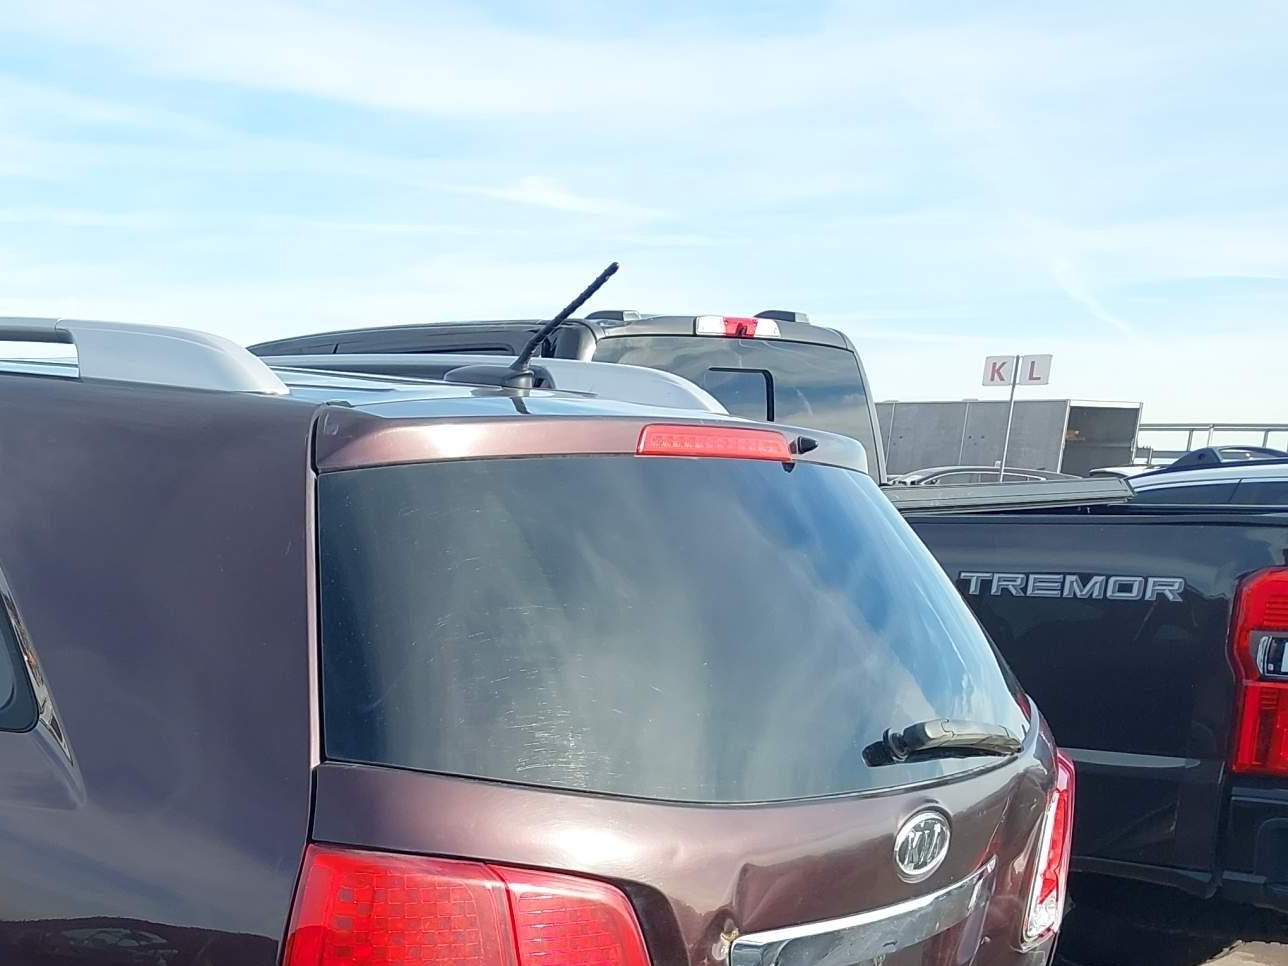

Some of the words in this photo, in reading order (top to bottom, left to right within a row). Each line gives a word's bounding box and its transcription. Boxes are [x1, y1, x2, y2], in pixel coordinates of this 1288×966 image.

[990, 361, 1008, 381] K
[1028, 360, 1041, 381] L
[960, 571, 1185, 602] TREMOR
[903, 822, 942, 866] KIA
